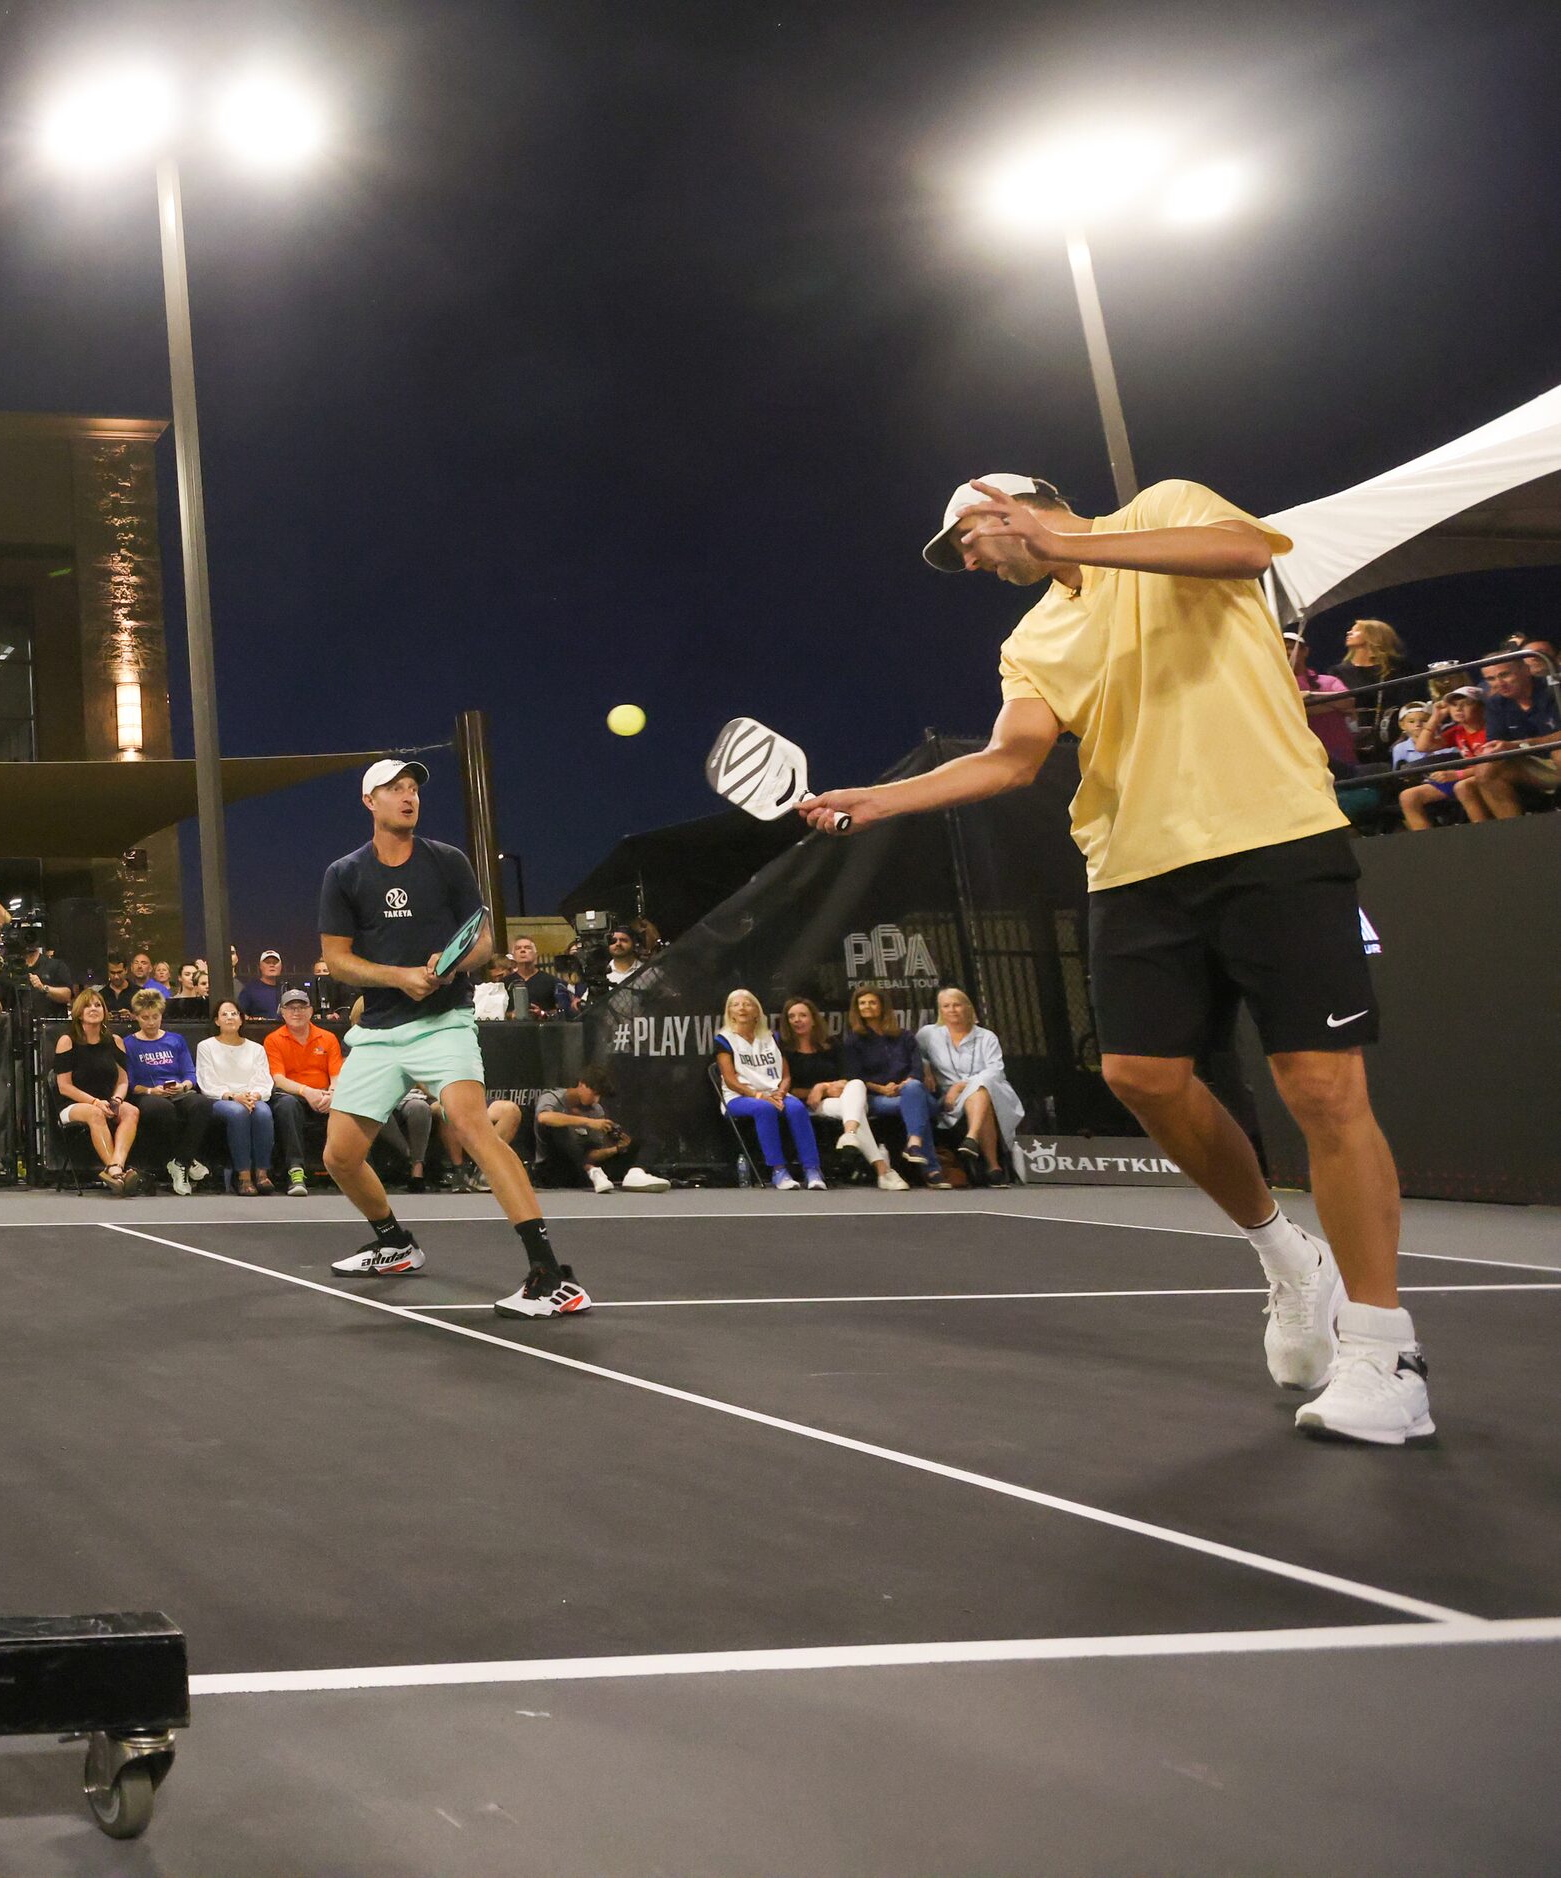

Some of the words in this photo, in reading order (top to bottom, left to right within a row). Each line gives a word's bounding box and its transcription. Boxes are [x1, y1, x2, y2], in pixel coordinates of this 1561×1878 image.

[383, 909, 413, 918] TAKEYA
[844, 924, 938, 977] PPA
[912, 978, 940, 989] TOUR
[613, 1015, 691, 1057] #PLAY
[739, 1052, 776, 1067] DALLAS
[766, 1066, 780, 1080] 41
[509, 1088, 529, 1106] THE
[1029, 1155, 1182, 1175] DRAFTKIN
[361, 1247, 413, 1267] adidas
